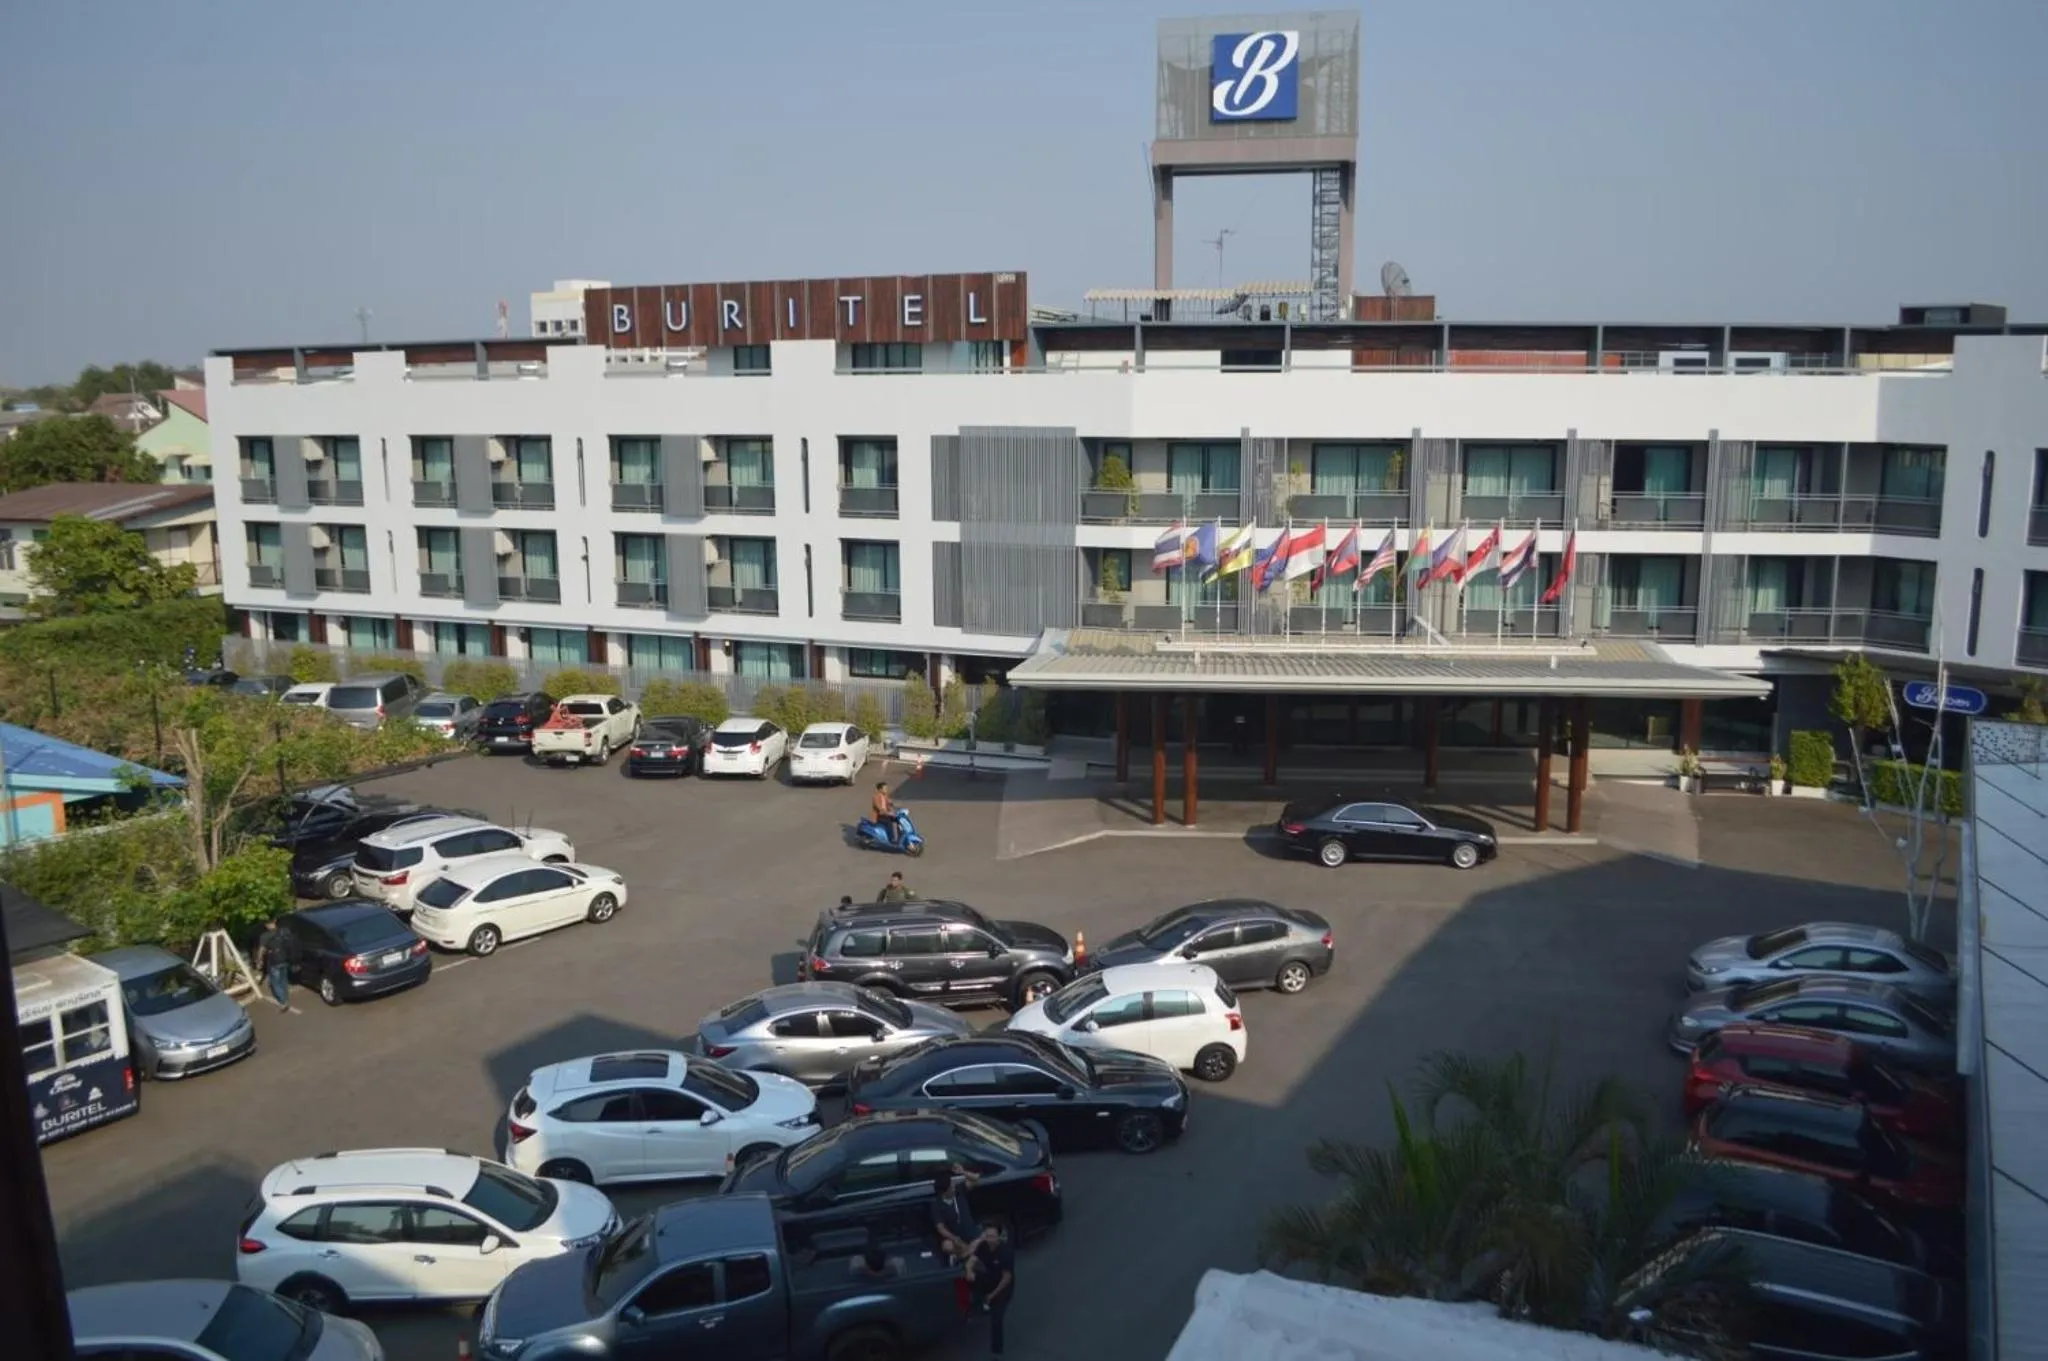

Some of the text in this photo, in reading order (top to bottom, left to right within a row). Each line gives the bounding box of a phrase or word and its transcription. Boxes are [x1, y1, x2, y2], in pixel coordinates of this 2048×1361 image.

[1213, 30, 1299, 116] B
[612, 291, 987, 334] BURITEL
[41, 1101, 107, 1131] BURITEL
